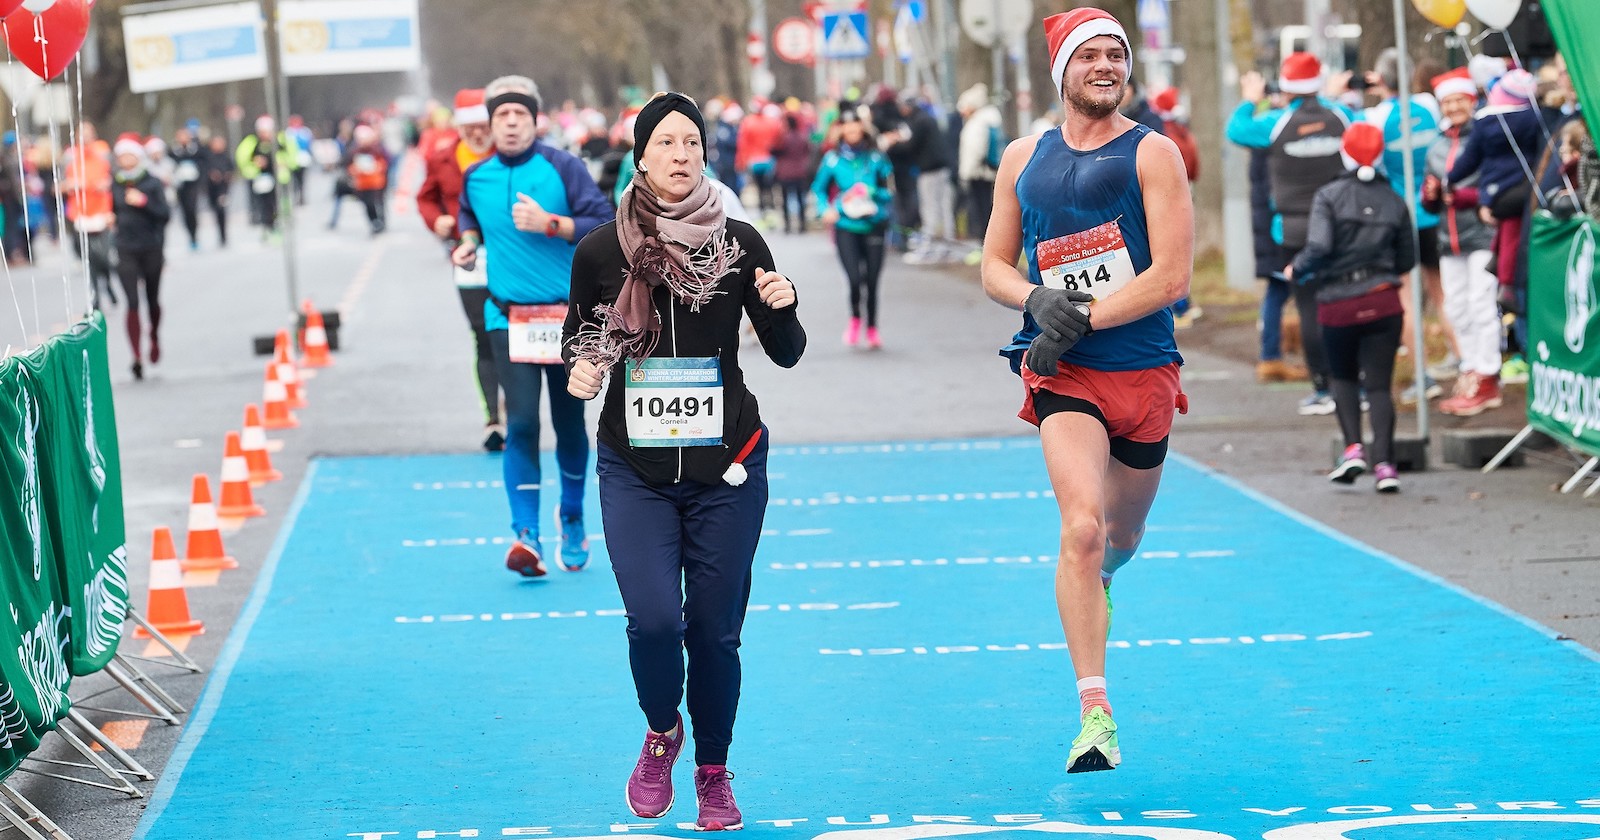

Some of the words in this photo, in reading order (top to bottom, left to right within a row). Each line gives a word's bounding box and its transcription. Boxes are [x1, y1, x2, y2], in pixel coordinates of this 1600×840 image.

[1061, 252, 1080, 263] Santa
[1081, 248, 1097, 257] Run
[1063, 264, 1111, 291] 814
[632, 396, 714, 417] 10491
[346, 826, 552, 840] THE
[1101, 809, 1198, 821] IS
